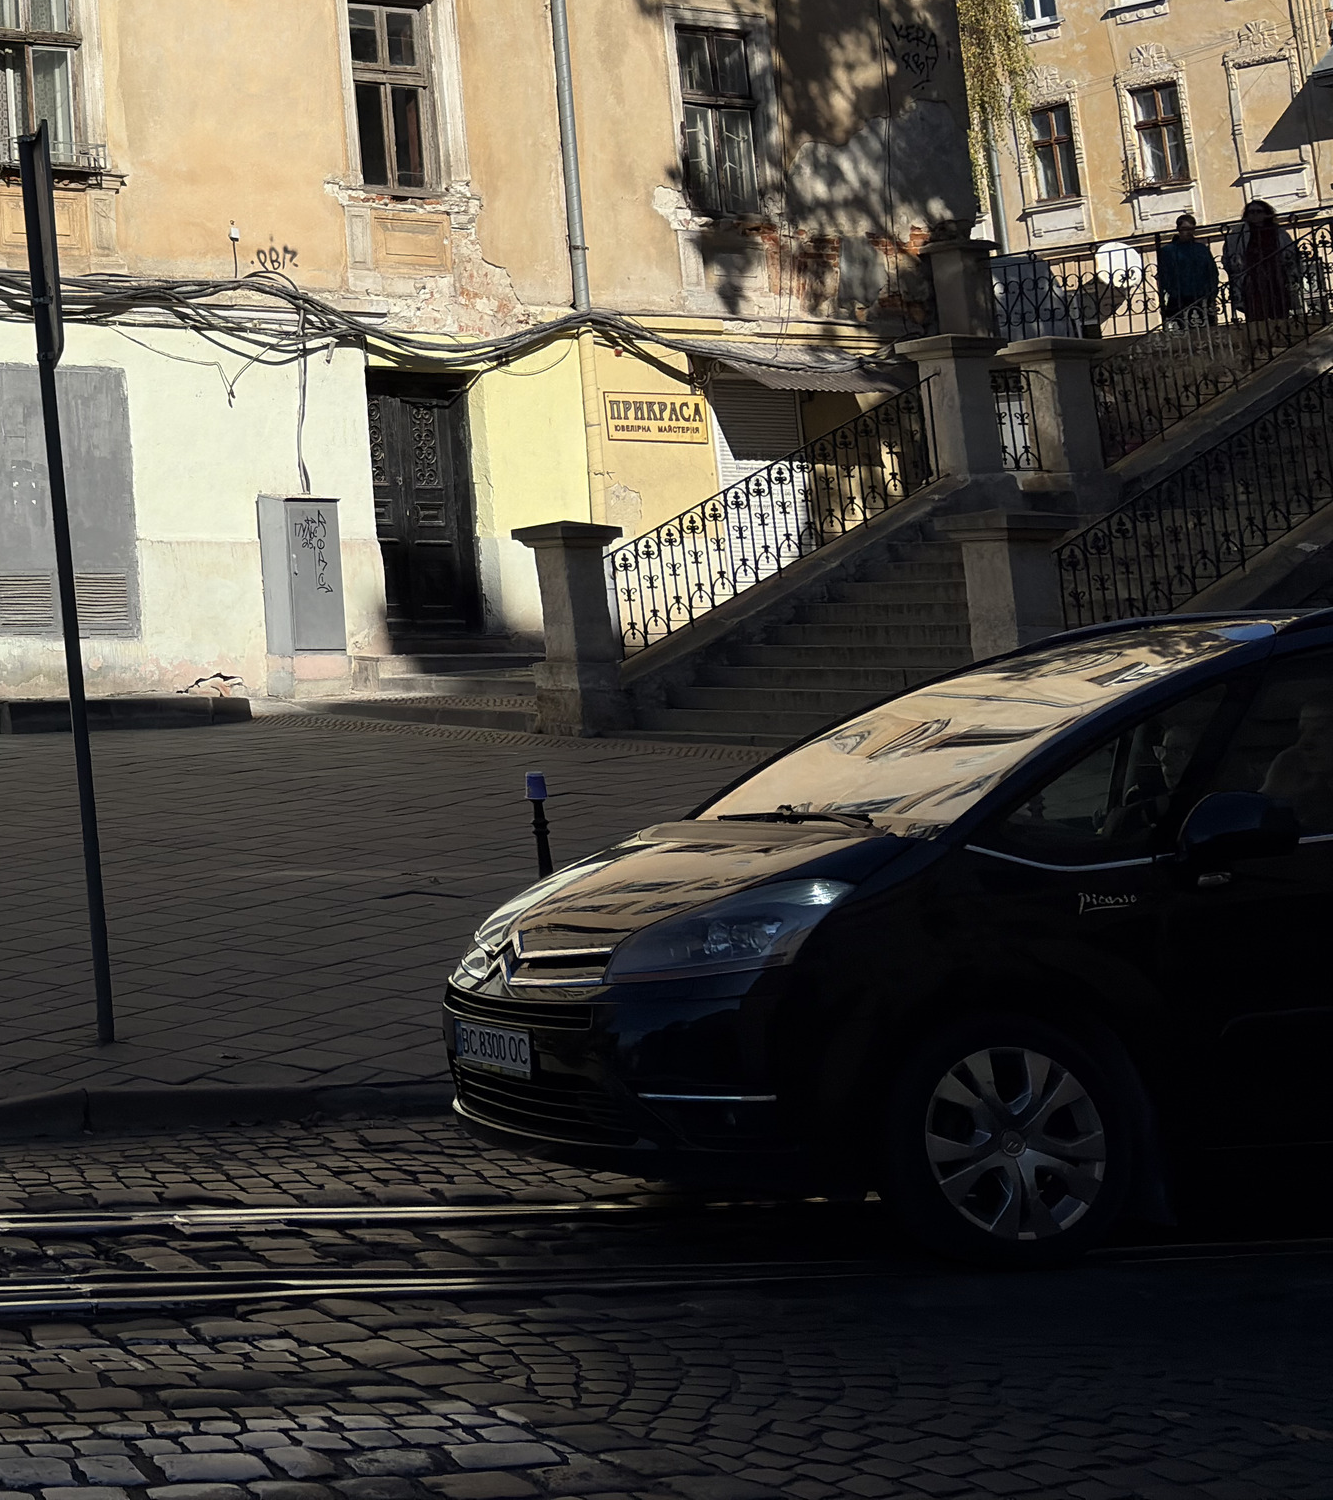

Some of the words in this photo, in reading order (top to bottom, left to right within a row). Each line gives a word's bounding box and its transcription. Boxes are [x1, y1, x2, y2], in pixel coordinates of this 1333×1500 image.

[609, 400, 704, 422] ПРИКРАСА
[614, 424, 651, 432] ЮВЕЛІРНА
[657, 424, 700, 434] МАЙСТЕРНЯ
[1078, 892, 1137, 915] Picasso
[461, 1027, 478, 1055] BC
[479, 1030, 506, 1061] 8300
